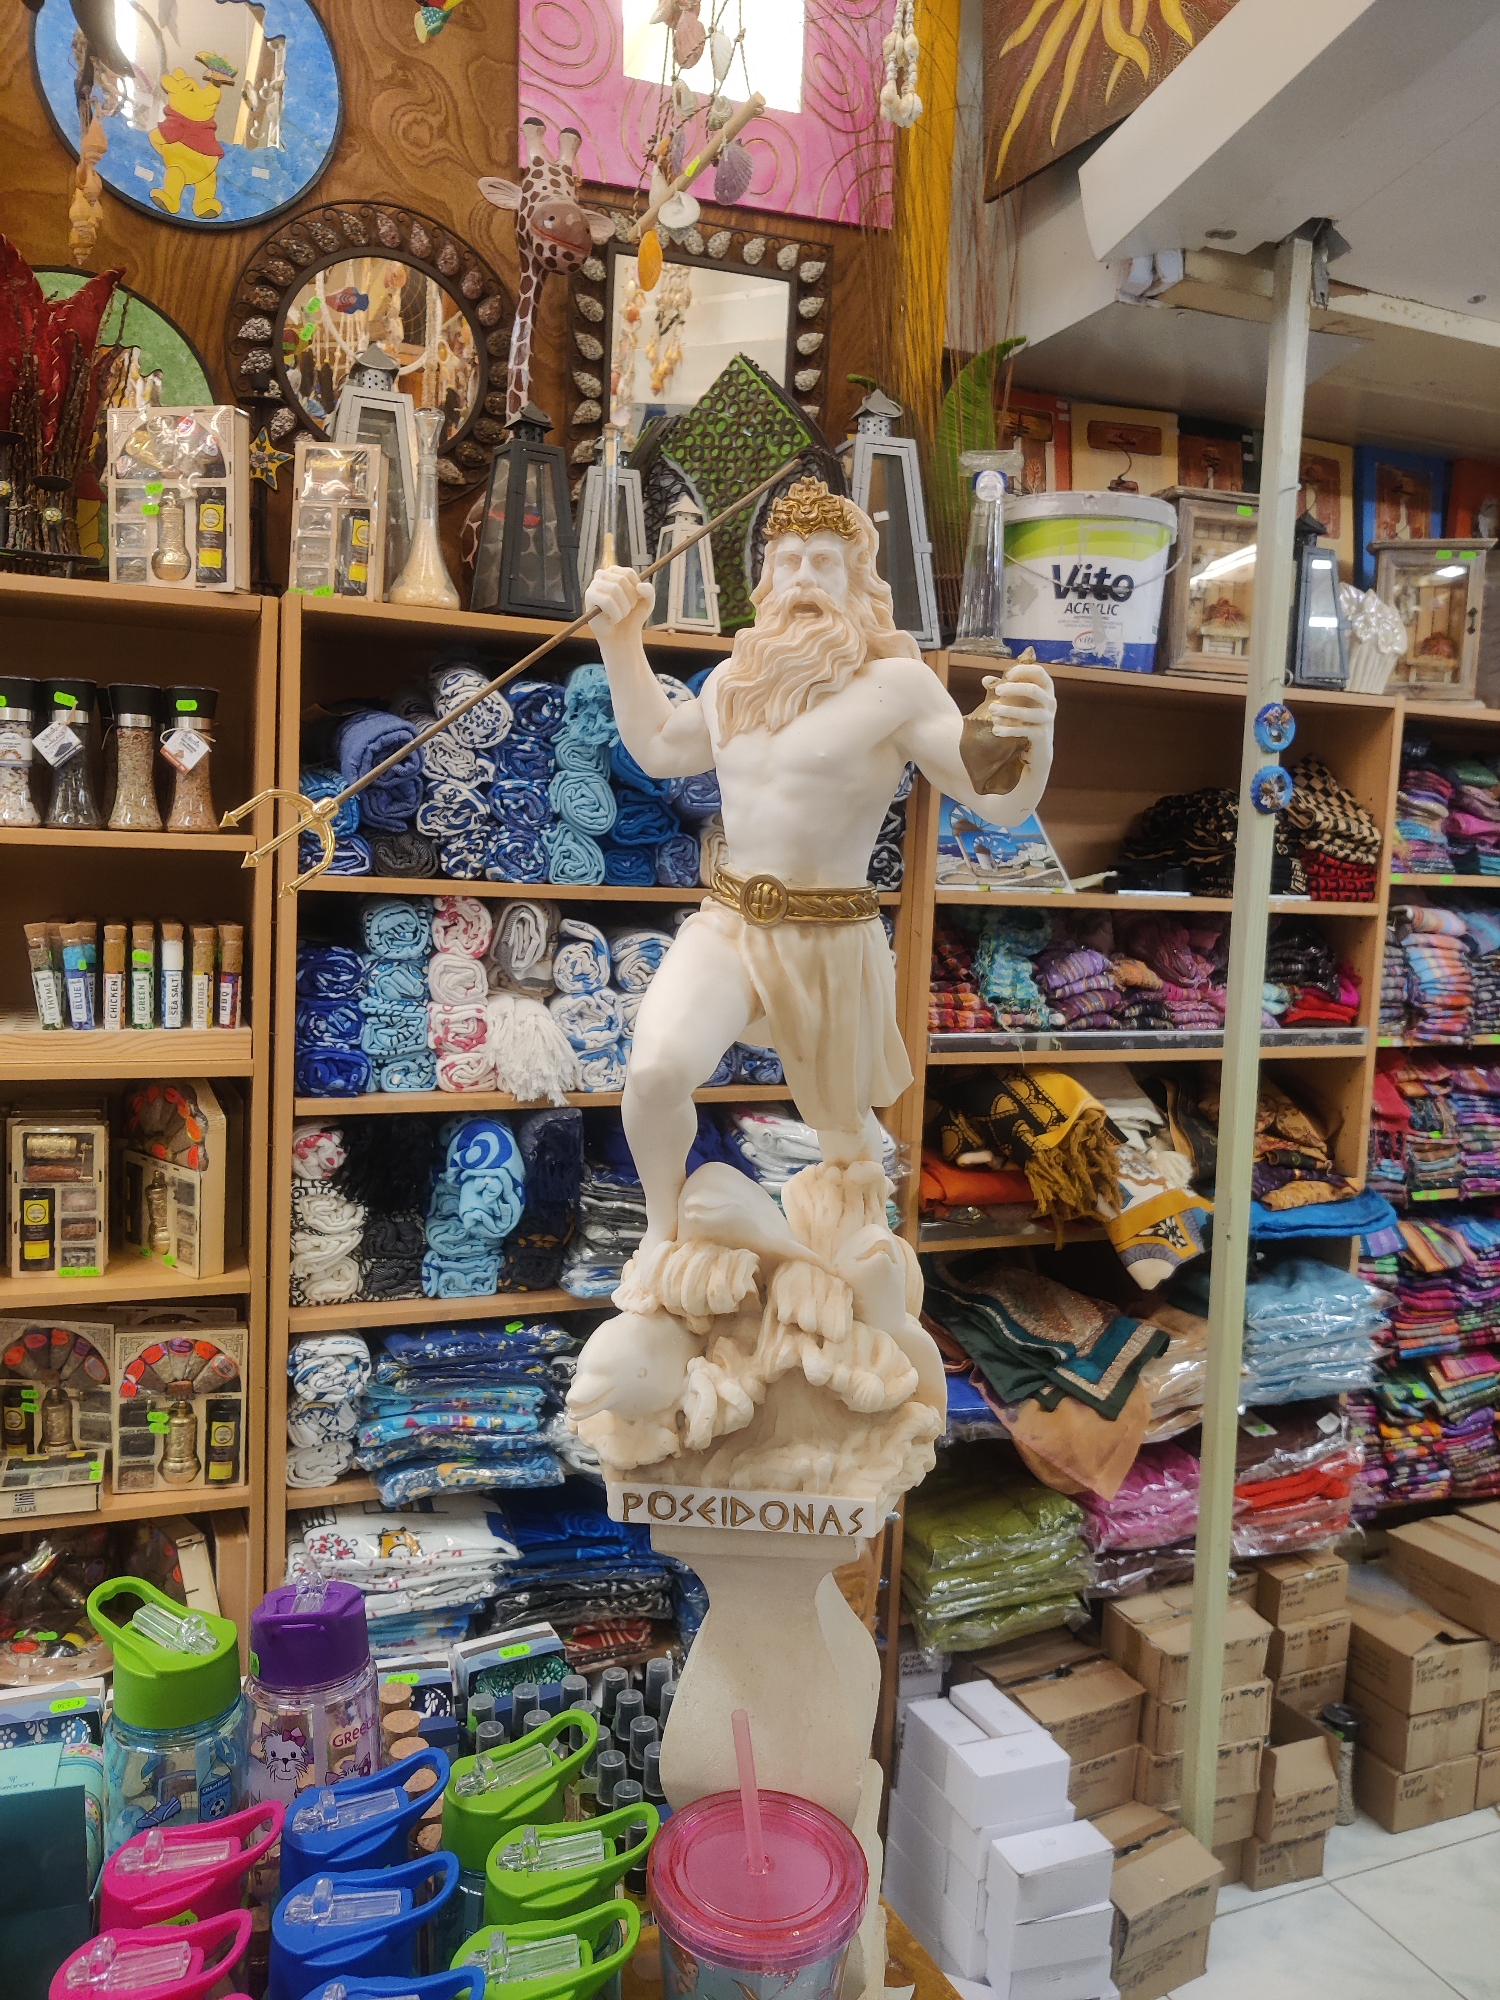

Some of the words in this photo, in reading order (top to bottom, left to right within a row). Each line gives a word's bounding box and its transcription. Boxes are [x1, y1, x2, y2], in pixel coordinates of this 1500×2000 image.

[1051, 563, 1134, 602] Vito
[73, 986, 83, 1010] BLUE
[109, 980, 119, 1019] CHICKEN
[138, 984, 146, 1012] GREEN
[171, 978, 179, 998] SALT
[197, 981, 205, 1020] POTATOES
[170, 1000, 179, 1016] SEA
[12, 1505, 37, 1514] HELLAS
[622, 1490, 864, 1536] POSEIDONAS
